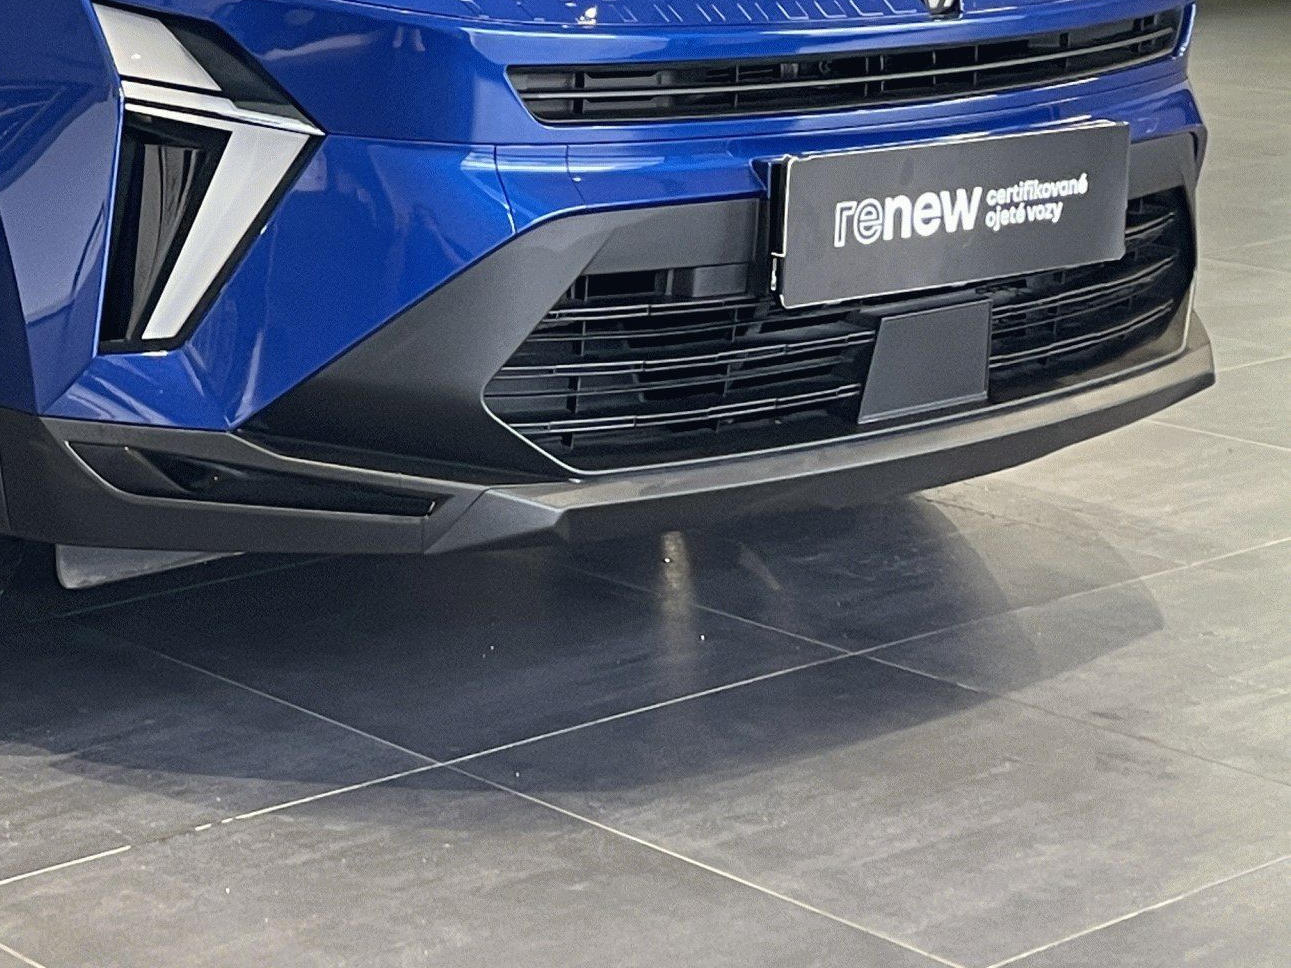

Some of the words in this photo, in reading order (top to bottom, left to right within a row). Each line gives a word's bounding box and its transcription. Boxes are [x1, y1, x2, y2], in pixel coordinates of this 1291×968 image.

[986, 172, 1089, 206] certifikované
[833, 187, 982, 248] renew
[984, 202, 1026, 232] ojeté
[1026, 200, 1064, 224] vozy
